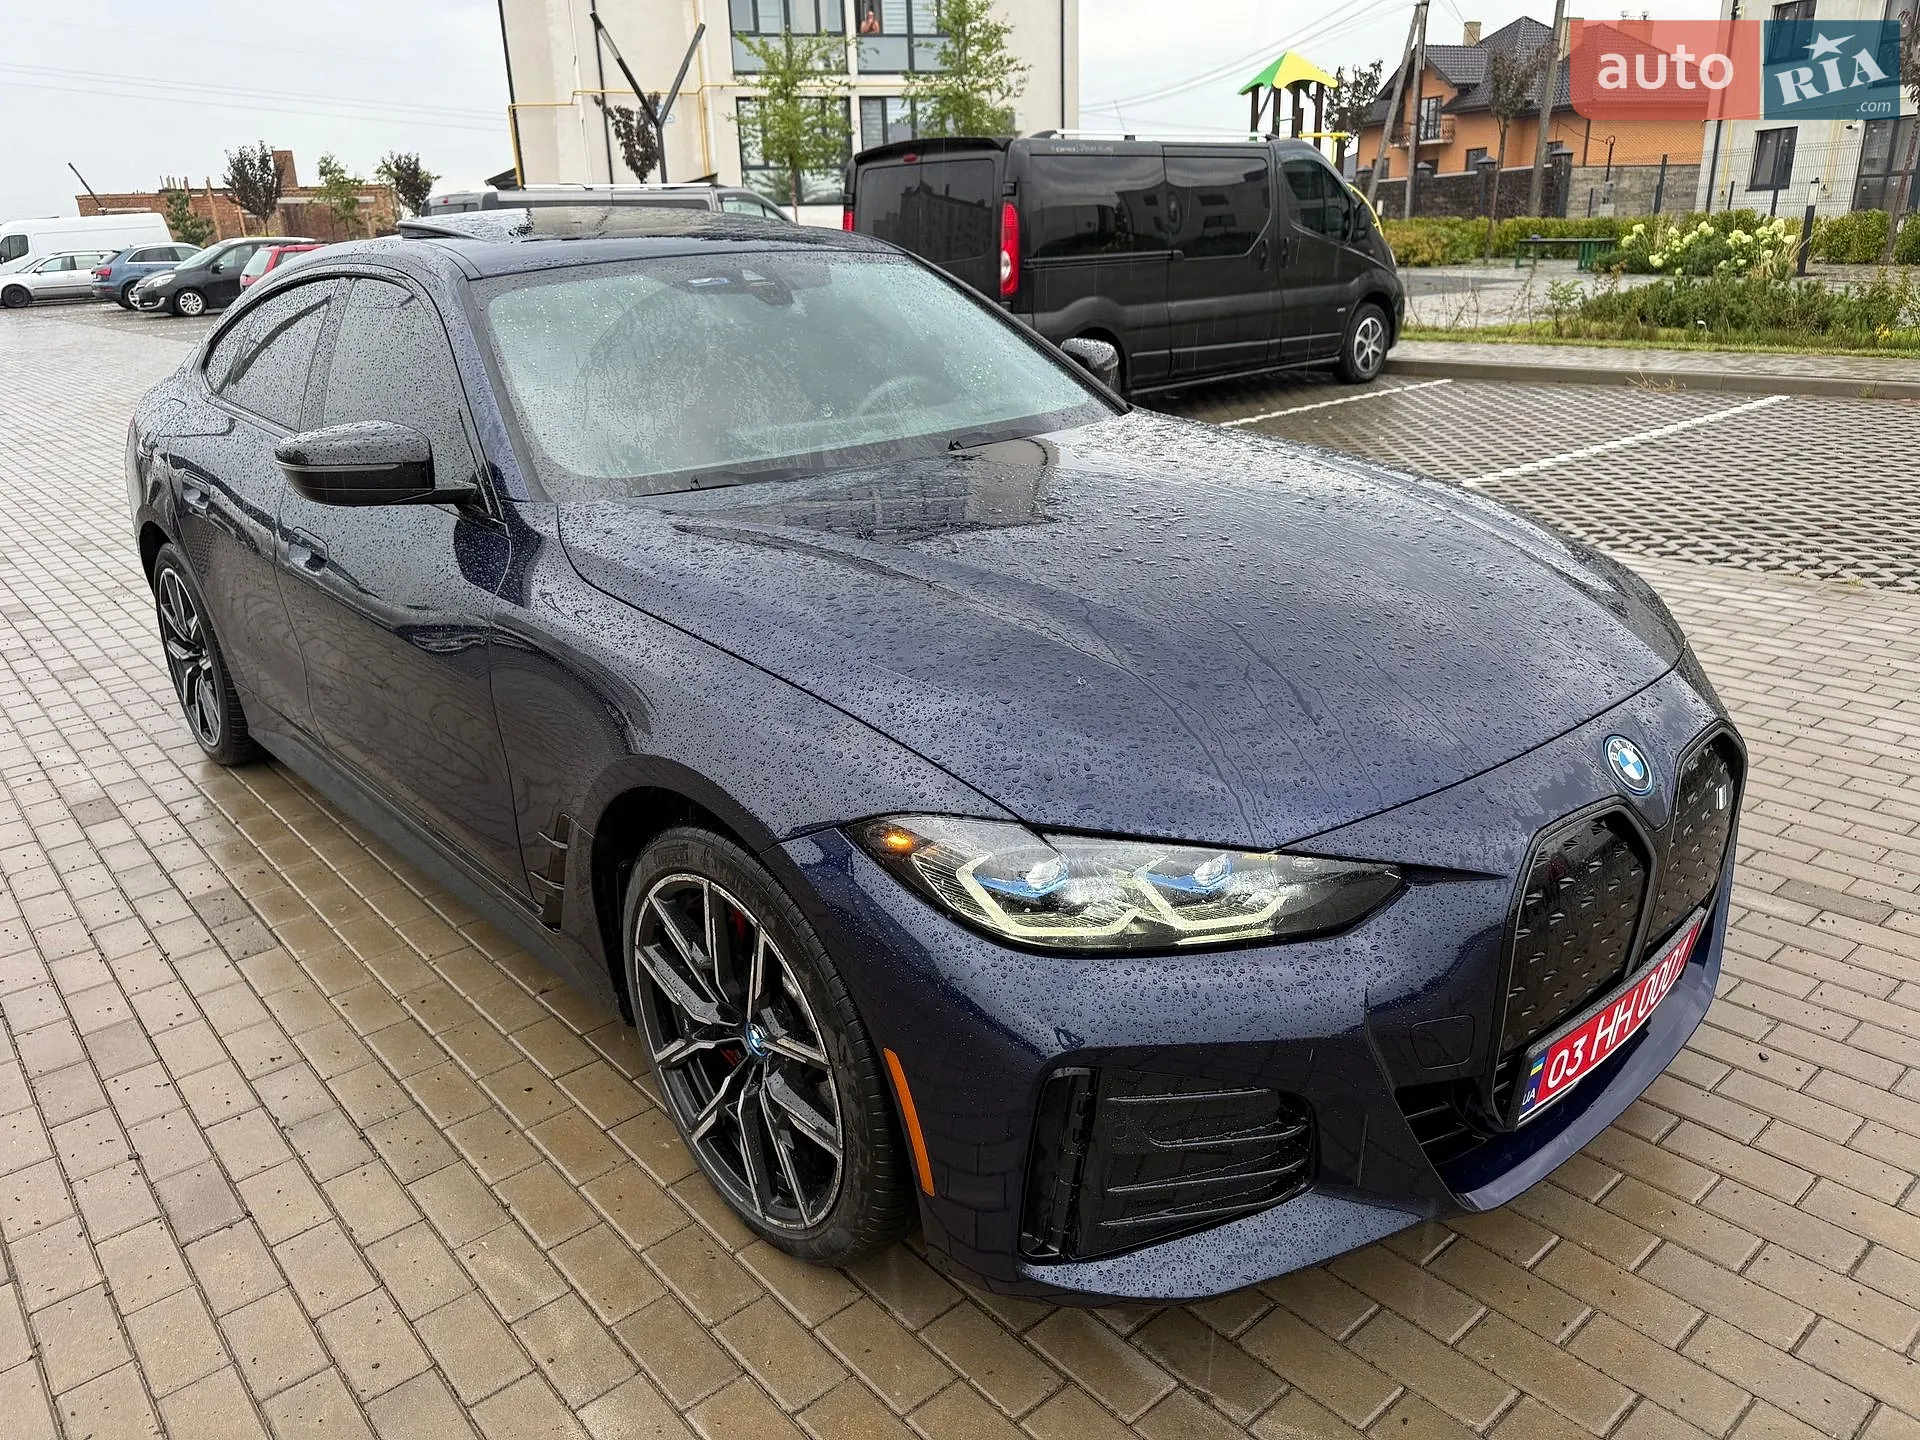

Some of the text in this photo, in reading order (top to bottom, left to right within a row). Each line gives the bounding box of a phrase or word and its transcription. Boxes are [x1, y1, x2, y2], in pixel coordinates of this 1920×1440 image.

[1547, 1033, 1589, 1088] 03
[1590, 988, 1639, 1062] HH
[1521, 1088, 1536, 1106] UA
